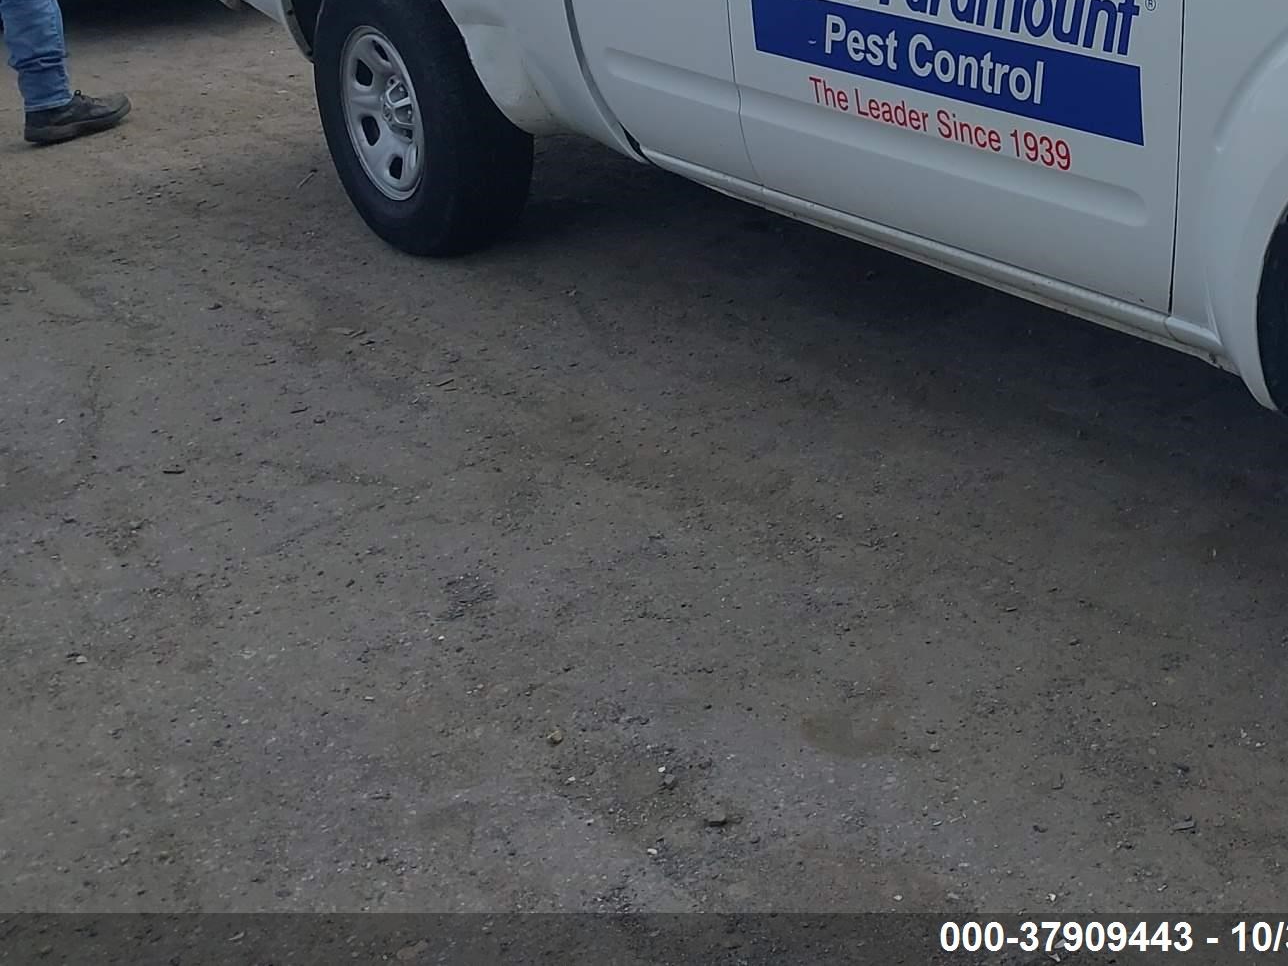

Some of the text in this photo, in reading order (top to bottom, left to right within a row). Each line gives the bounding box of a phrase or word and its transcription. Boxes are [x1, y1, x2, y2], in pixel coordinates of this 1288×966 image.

[824, 14, 1045, 105] Pest Control
[809, 76, 1071, 171] The Leader Since 1939
